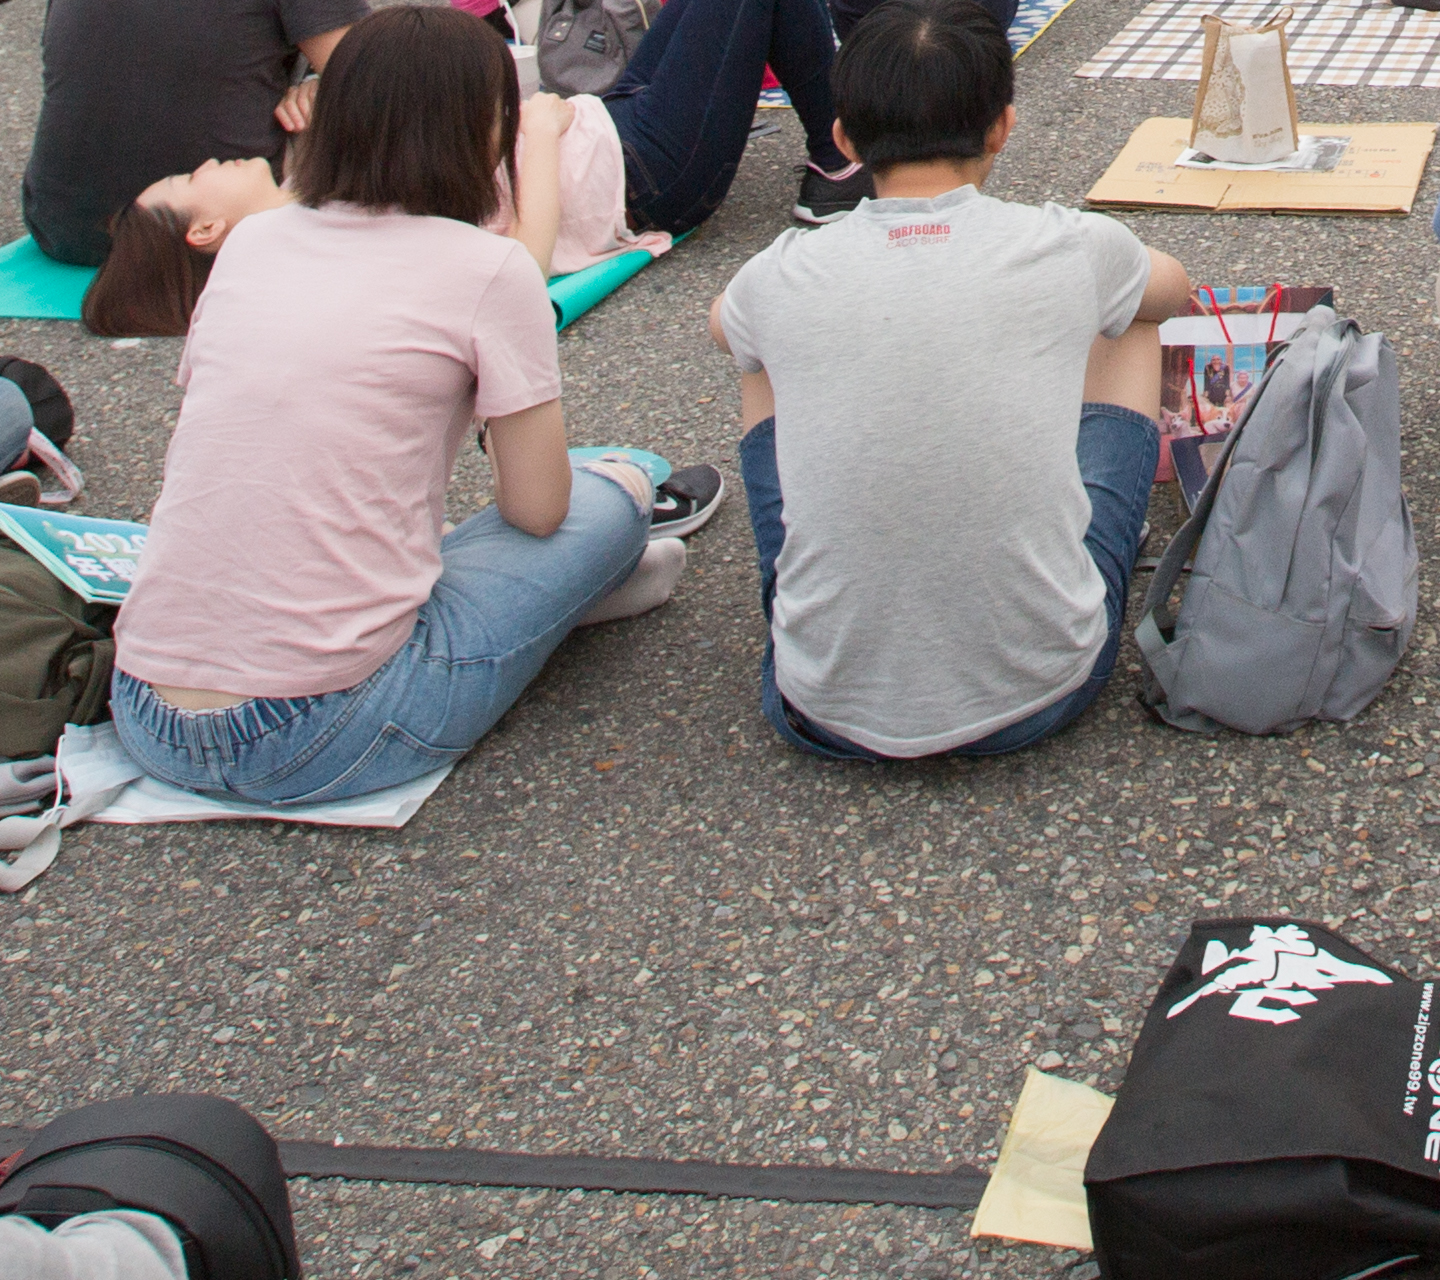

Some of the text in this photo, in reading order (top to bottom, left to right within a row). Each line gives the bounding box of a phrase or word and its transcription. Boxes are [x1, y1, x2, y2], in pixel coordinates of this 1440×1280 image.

[888, 224, 951, 241] SURFBOARD
[886, 235, 951, 250] CACO SURF
[1403, 982, 1434, 1115] www.zipzone99.tw
